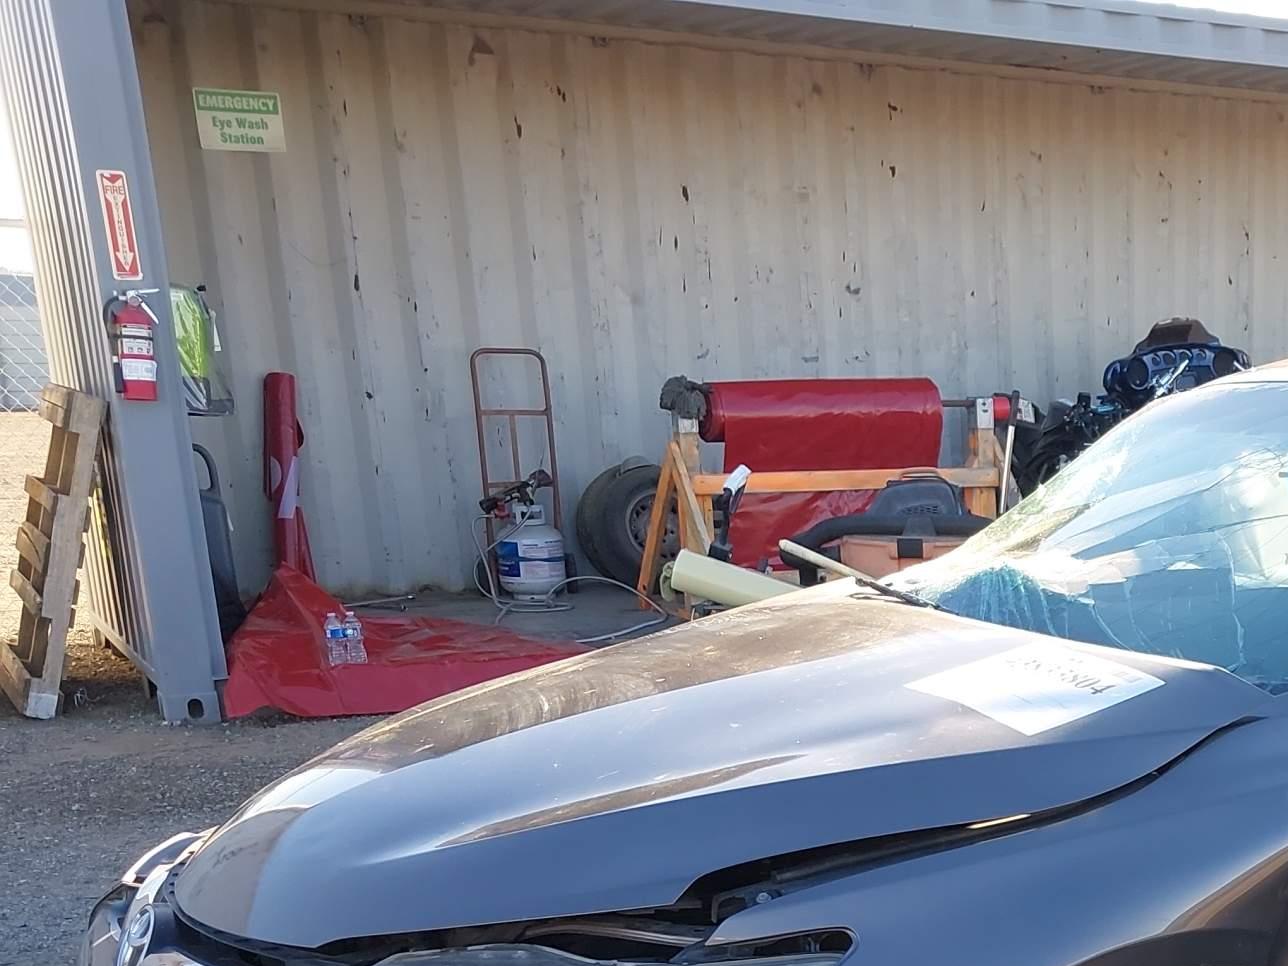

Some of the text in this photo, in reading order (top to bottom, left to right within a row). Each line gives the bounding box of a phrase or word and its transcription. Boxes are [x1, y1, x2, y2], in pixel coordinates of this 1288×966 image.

[198, 94, 275, 111] EMERGENCY
[212, 116, 269, 130] Eye Wash
[220, 132, 264, 145] Station
[105, 185, 125, 195] FIRE
